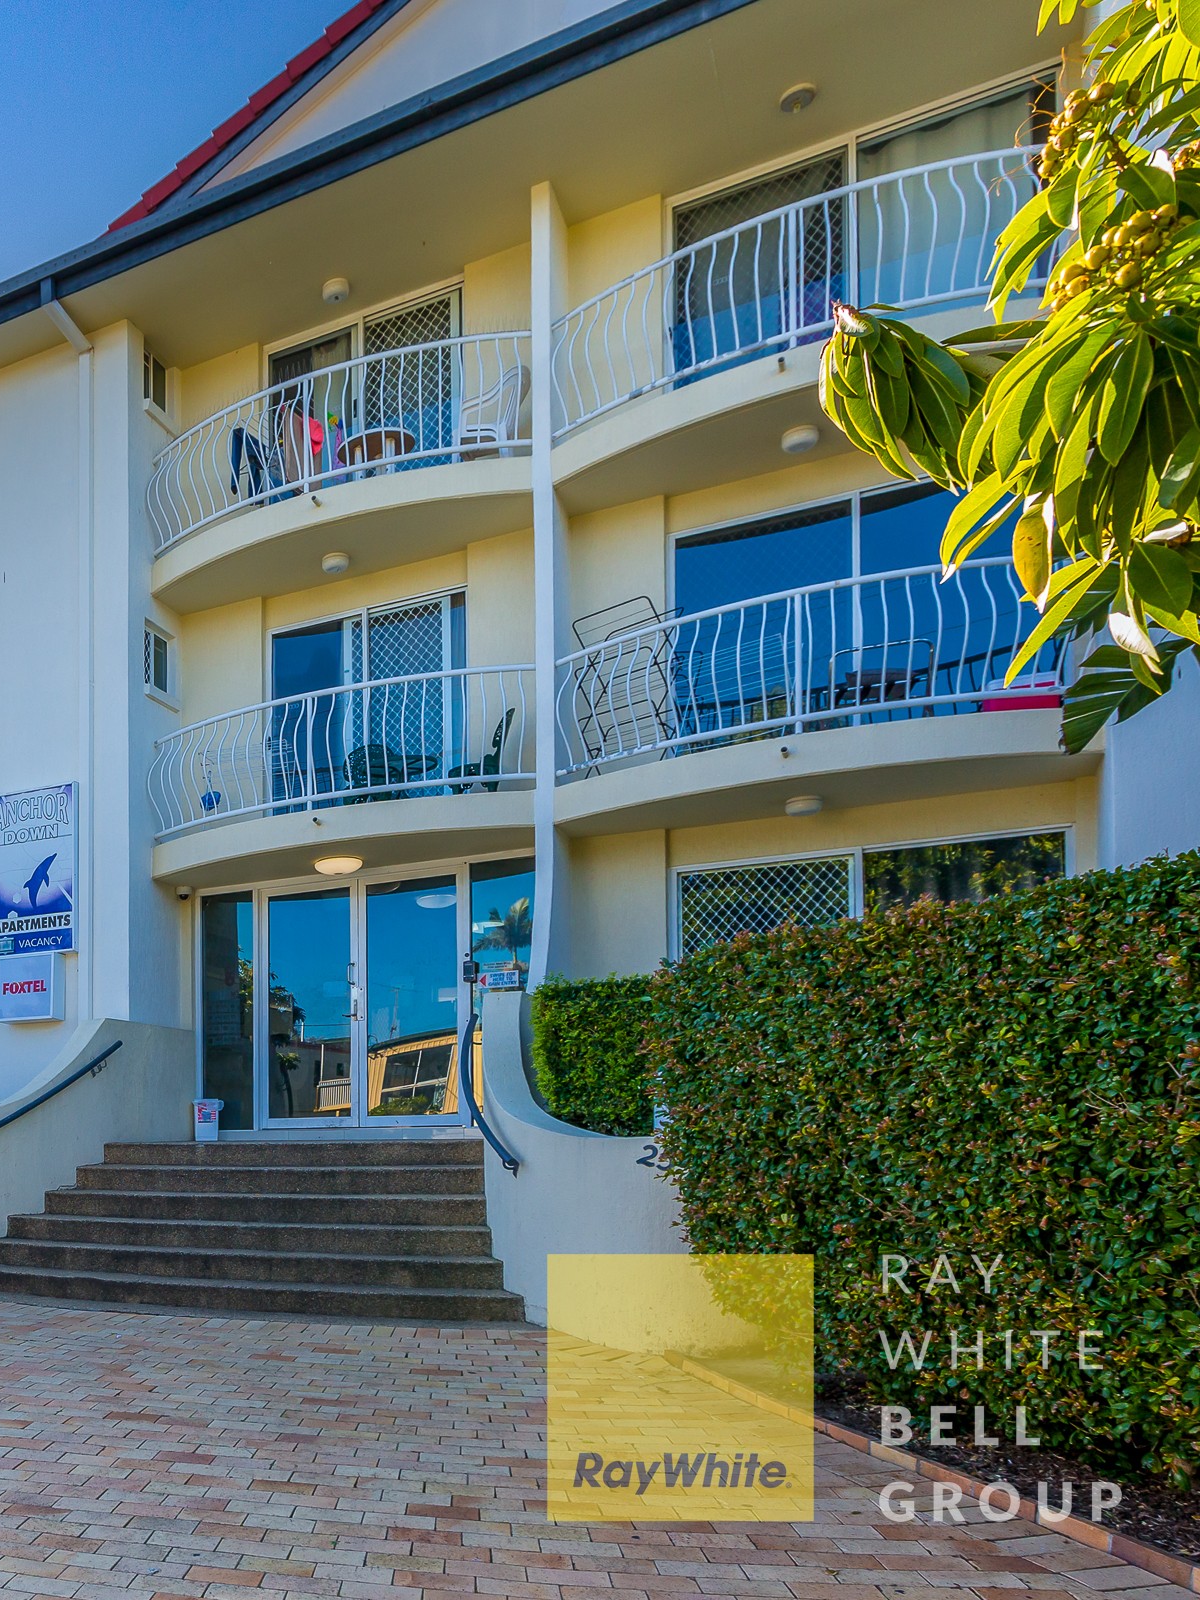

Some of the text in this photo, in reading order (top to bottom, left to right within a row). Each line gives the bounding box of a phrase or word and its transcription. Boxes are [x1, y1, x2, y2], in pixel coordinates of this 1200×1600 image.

[4, 824, 59, 845] DOWN
[18, 936, 63, 949] VACANCY
[2, 979, 47, 996] FOXTEL
